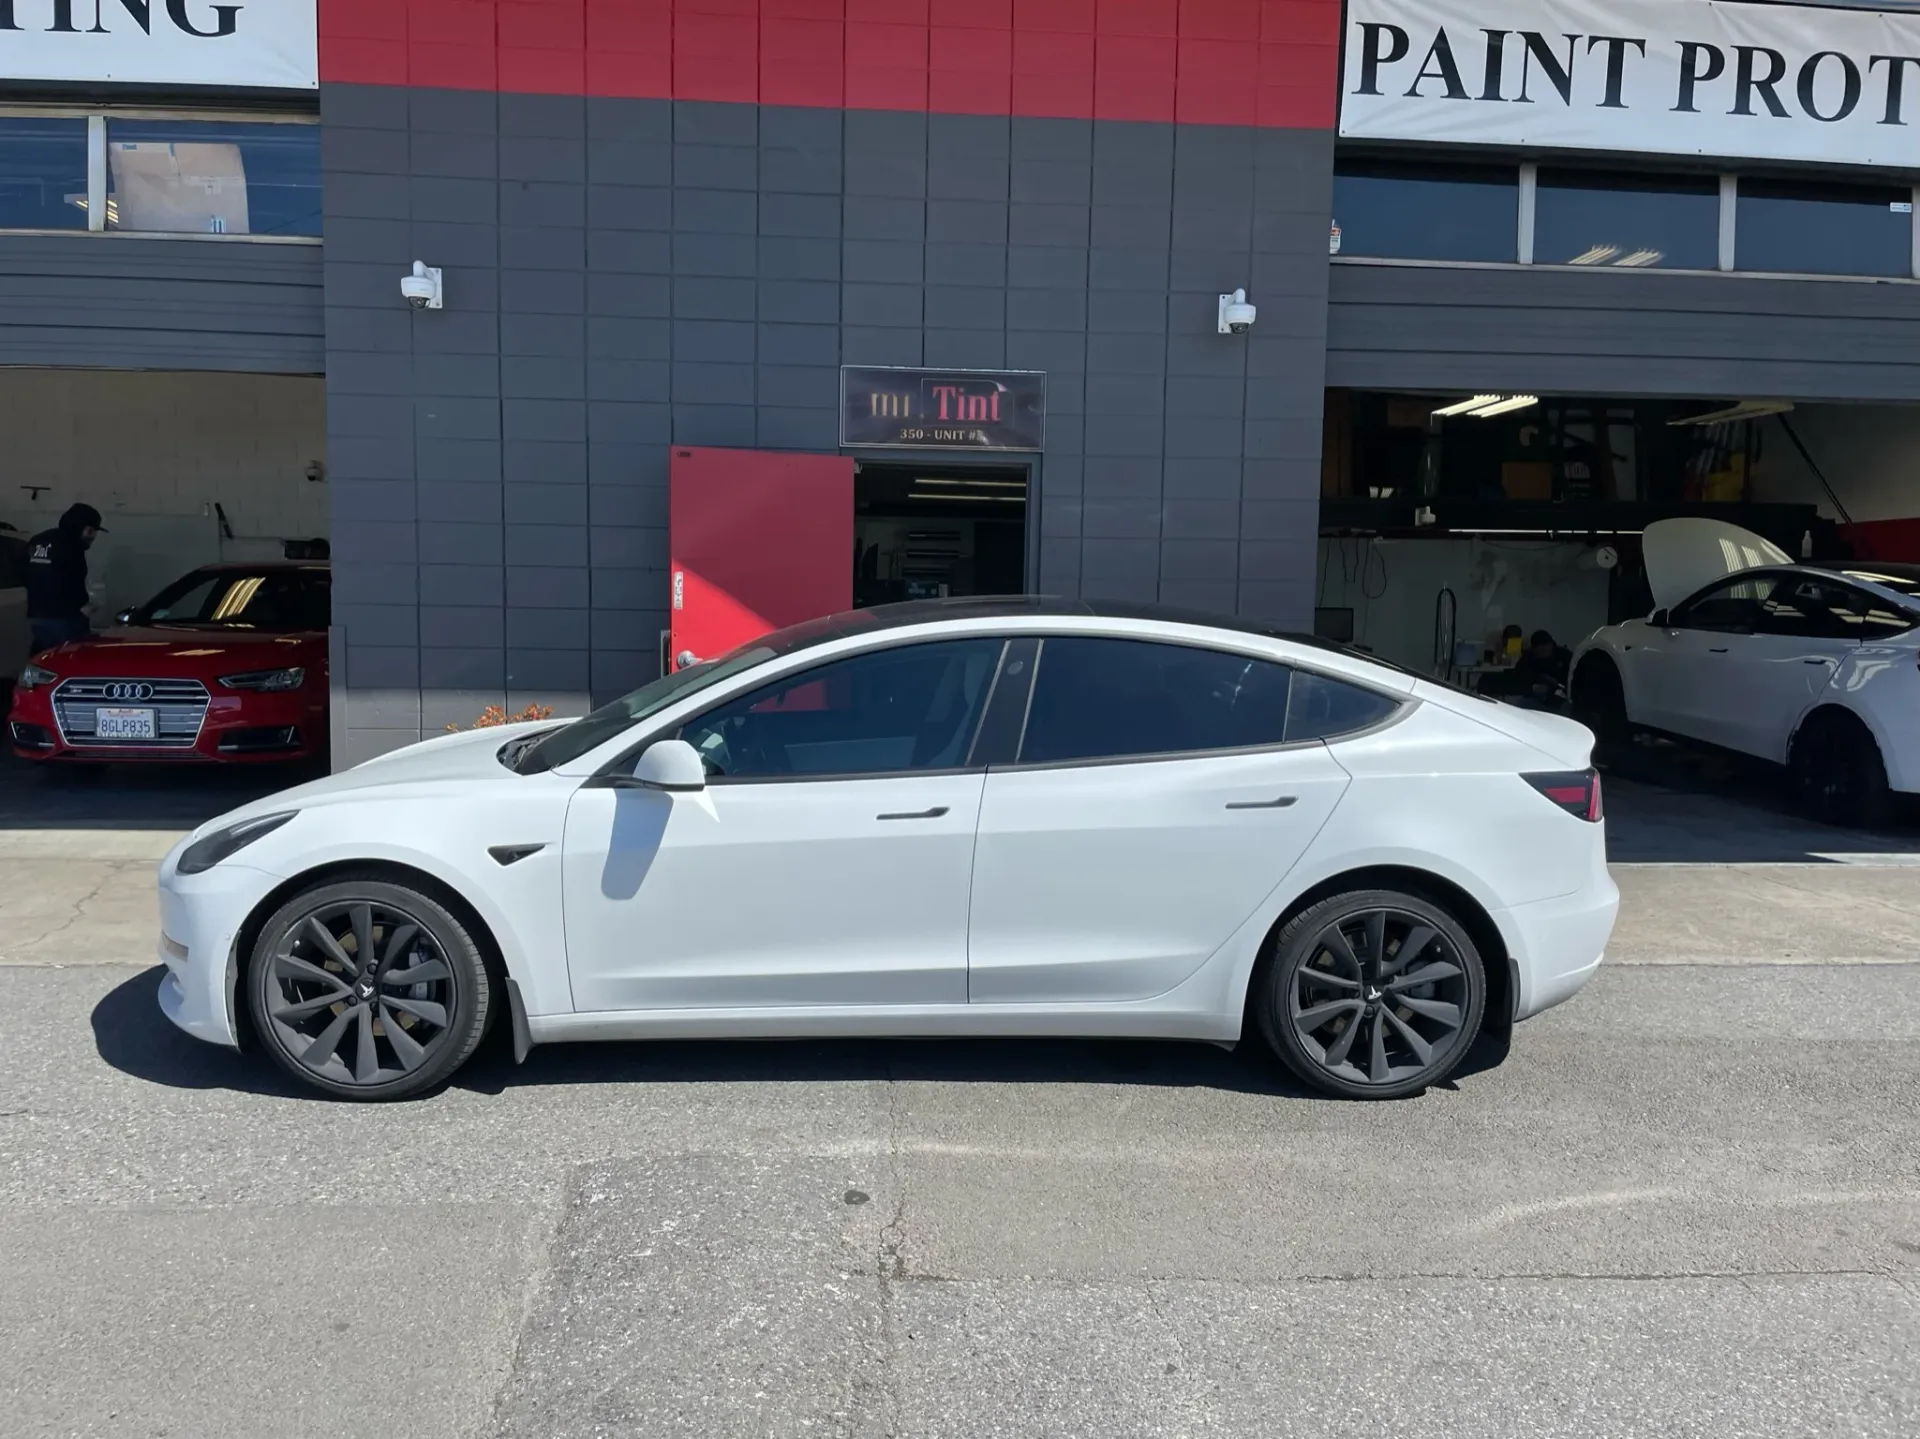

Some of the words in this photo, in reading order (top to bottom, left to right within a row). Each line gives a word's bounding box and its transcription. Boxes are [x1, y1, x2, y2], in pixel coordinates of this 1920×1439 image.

[1351, 21, 1647, 108] PAINT
[1669, 41, 1920, 126] PROT
[932, 385, 1000, 421] Tint
[900, 428, 924, 440] 350
[934, 429, 966, 441] UNIT
[101, 719, 151, 733] 8GLP835
